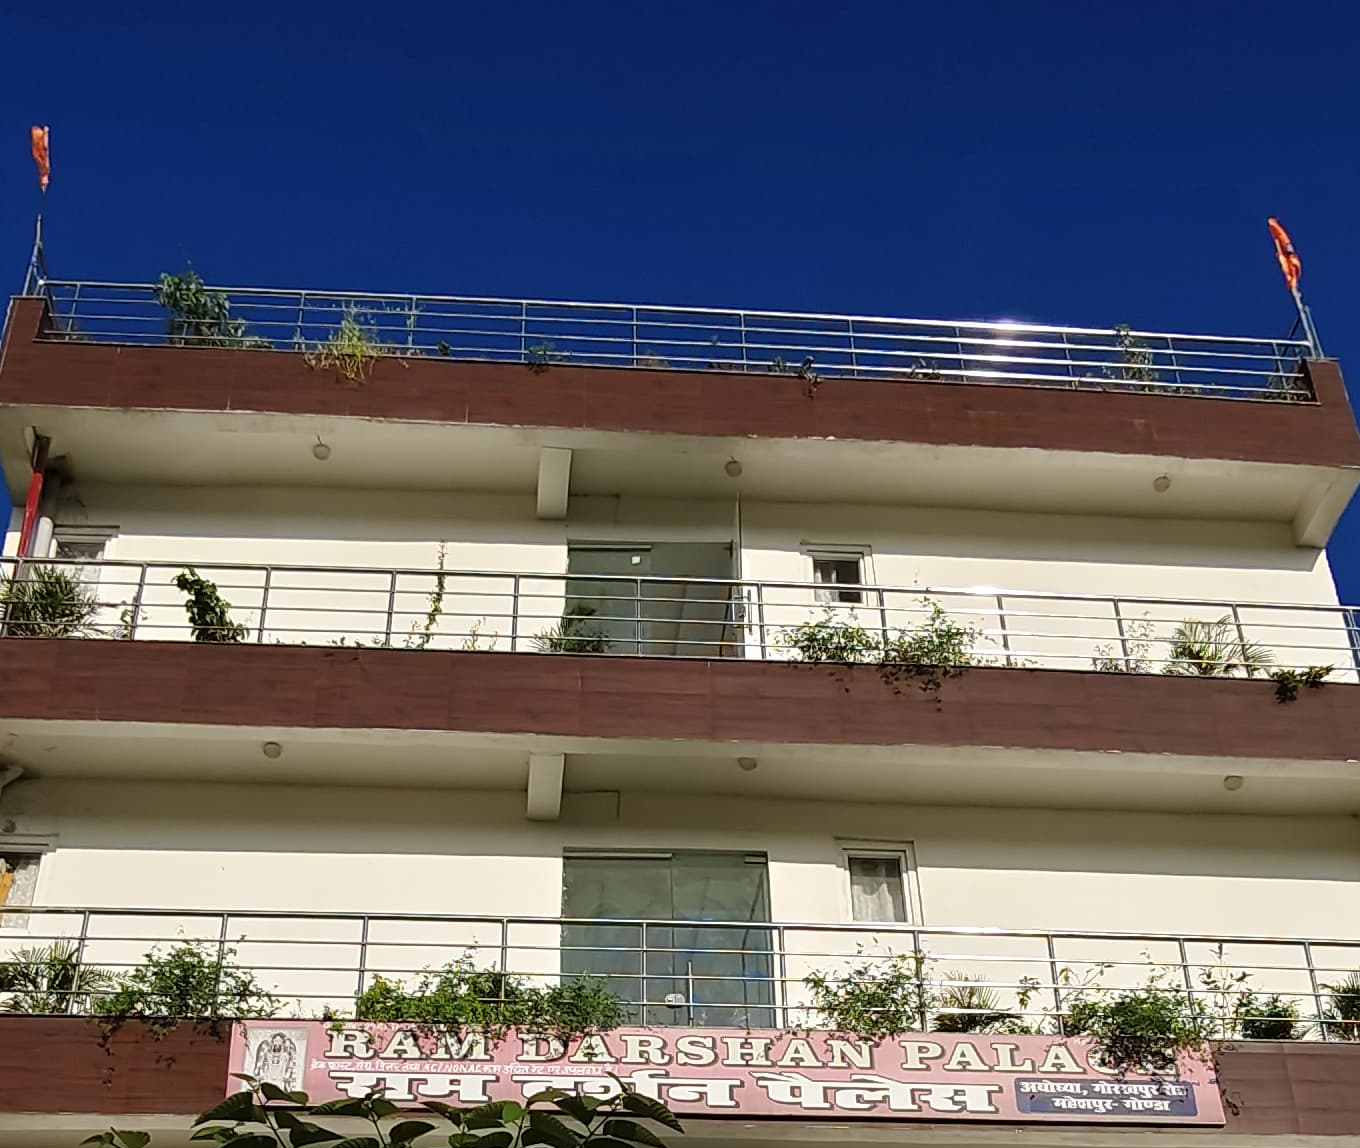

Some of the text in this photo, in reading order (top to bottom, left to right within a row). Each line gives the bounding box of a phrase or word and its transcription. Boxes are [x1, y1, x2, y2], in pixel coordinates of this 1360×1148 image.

[324, 1028, 493, 1062] RAM
[516, 1031, 875, 1069] DARSHAN
[329, 1071, 498, 1103] राम
[749, 1071, 1002, 1112] पैलेस
